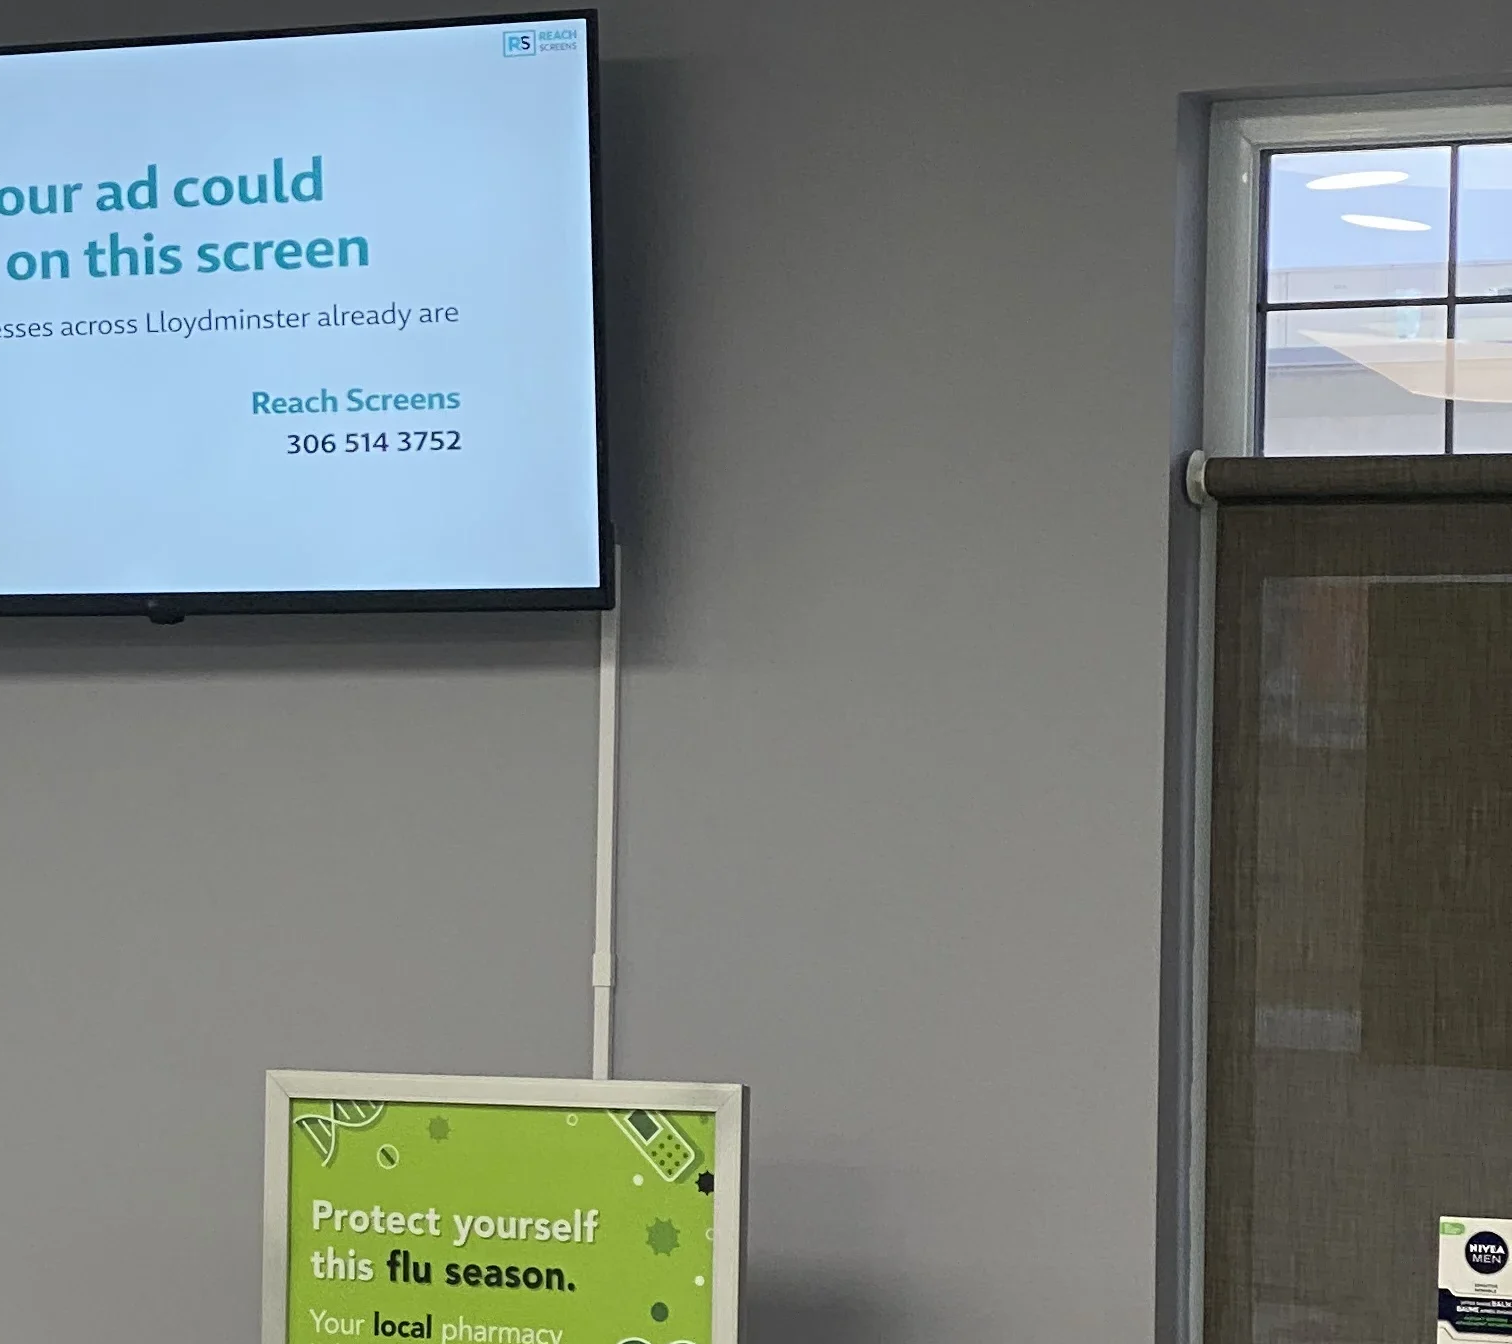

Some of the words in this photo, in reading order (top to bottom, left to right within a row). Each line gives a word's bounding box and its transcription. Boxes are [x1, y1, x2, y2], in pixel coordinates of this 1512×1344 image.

[508, 35, 531, 51] RS
[538, 29, 577, 41] REACH
[539, 42, 577, 52] SCREENS
[95, 164, 159, 214] ad
[173, 156, 325, 209] could
[6, 244, 72, 282] on
[84, 232, 183, 279] this
[196, 234, 371, 274] screen
[61, 313, 138, 338] across
[145, 306, 311, 340] Lloydminster
[317, 302, 413, 332] already
[419, 304, 460, 327] are
[251, 388, 339, 417] Reach
[346, 386, 461, 414] Screens
[286, 432, 337, 456] 306
[344, 432, 390, 455] 514
[397, 429, 462, 454] 3752
[310, 1199, 442, 1238] Protect
[453, 1208, 600, 1247] yourself
[1469, 1243, 1506, 1255] NIVEA
[1472, 1254, 1502, 1264] MEN
[310, 1247, 374, 1281] this
[386, 1250, 433, 1284] flu
[445, 1258, 577, 1292] season.
[309, 1309, 367, 1337] Your
[373, 1311, 433, 1340] local
